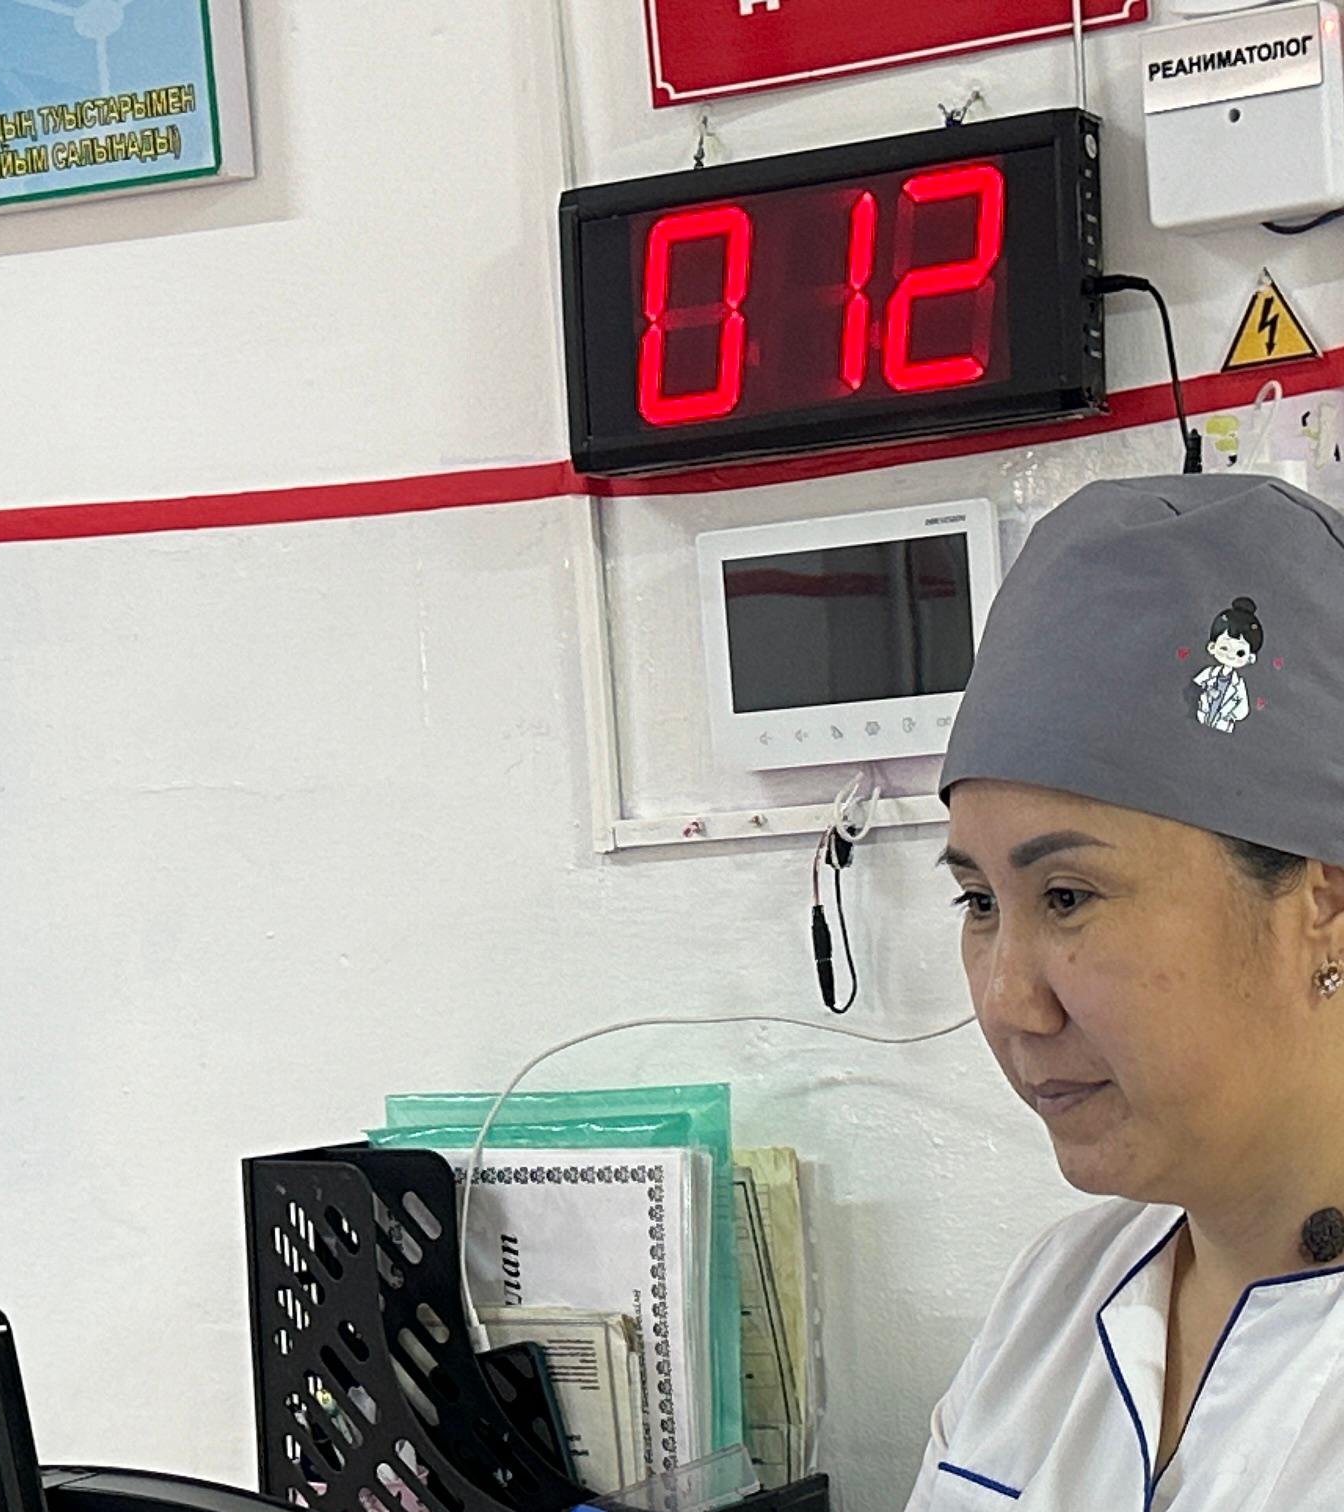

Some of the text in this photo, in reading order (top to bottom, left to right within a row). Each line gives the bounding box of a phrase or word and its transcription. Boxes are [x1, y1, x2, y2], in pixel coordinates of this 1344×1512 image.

[1147, 36, 1313, 82] РЕАНИМАТОЛОГ
[41, 84, 196, 135] ТУЫСТАРЫМЕН
[637, 162, 1007, 428] 012
[500, 1233, 523, 1306] лан
